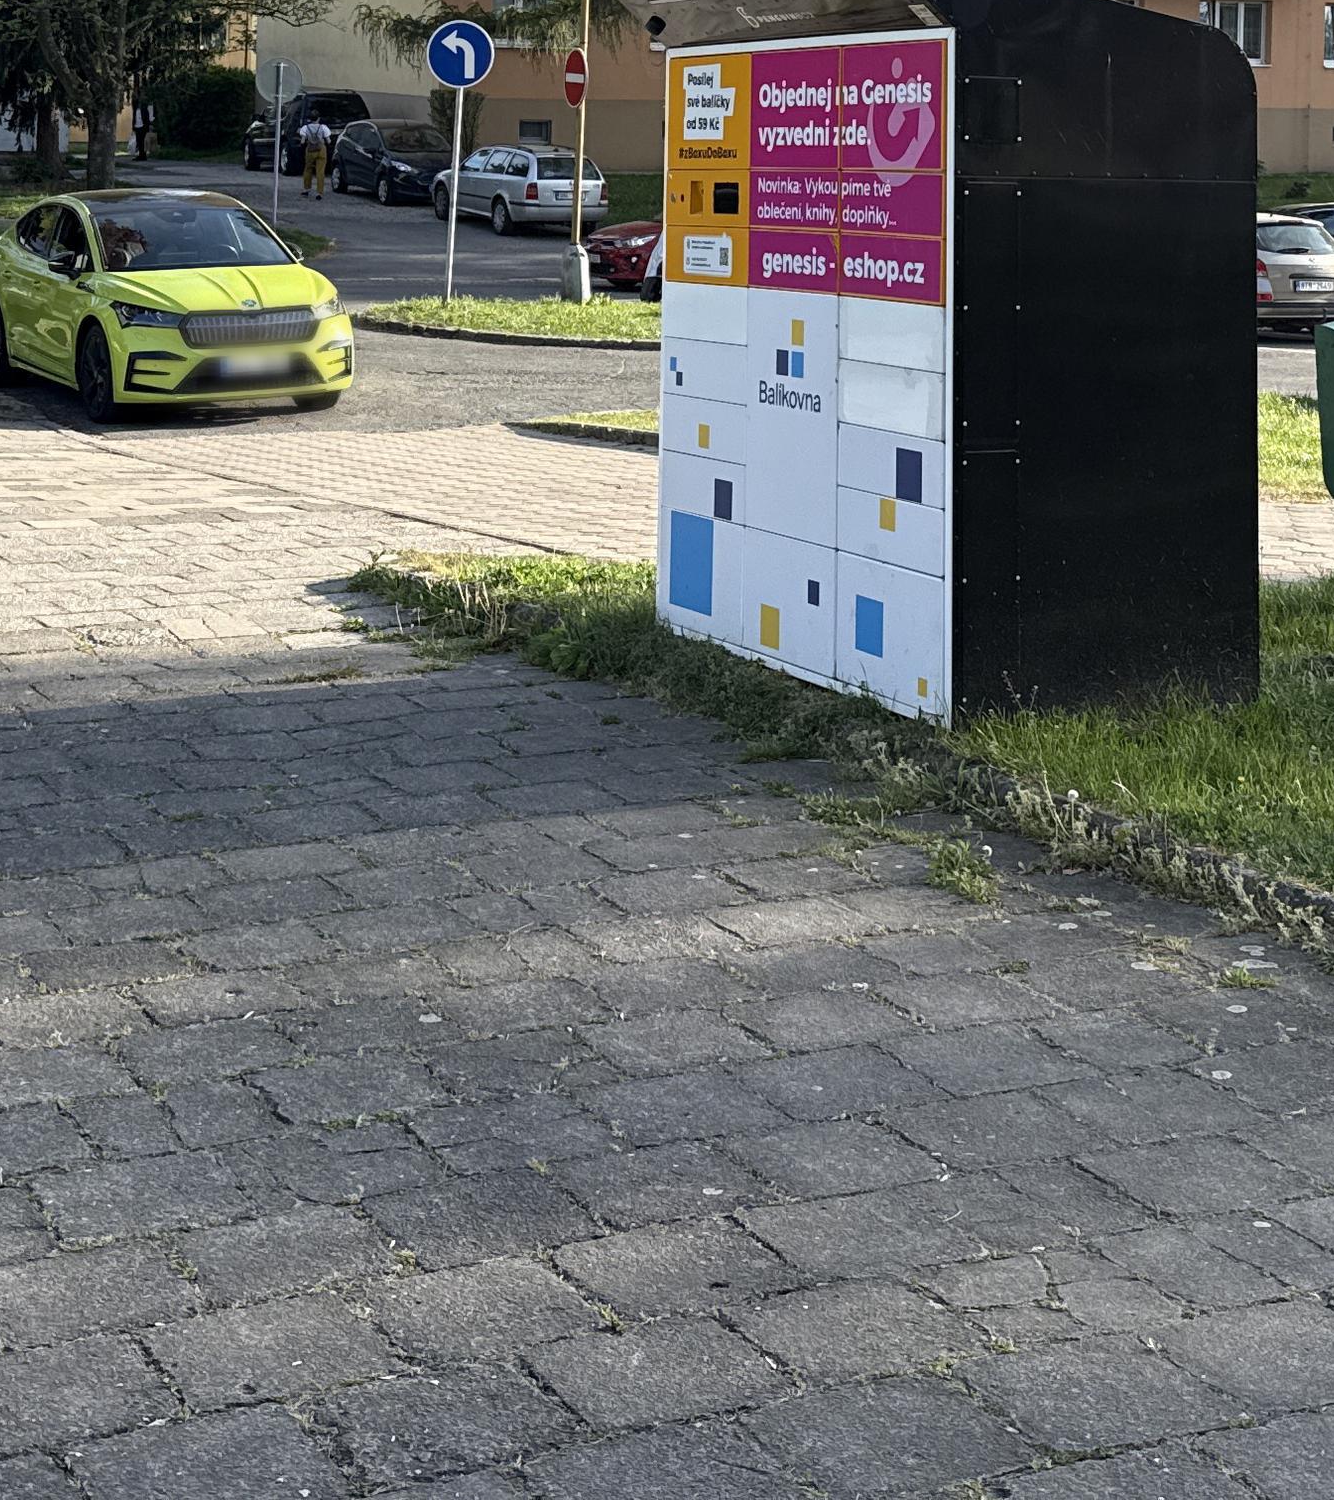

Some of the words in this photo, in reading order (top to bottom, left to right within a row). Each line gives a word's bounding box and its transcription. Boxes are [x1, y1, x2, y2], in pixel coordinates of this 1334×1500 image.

[687, 94, 700, 108] své
[759, 78, 832, 113] Objednej
[835, 84, 858, 106] na
[861, 73, 932, 105] Genesis
[686, 117, 696, 129] od
[709, 117, 720, 131] Kč
[758, 118, 830, 152] vyzvedni
[833, 119, 871, 146] zde.
[757, 176, 802, 194] Novinka:
[873, 179, 892, 197] tvé
[757, 201, 804, 222] oblečení,
[805, 203, 838, 226] knihy,
[759, 380, 821, 413] Balíkovna
